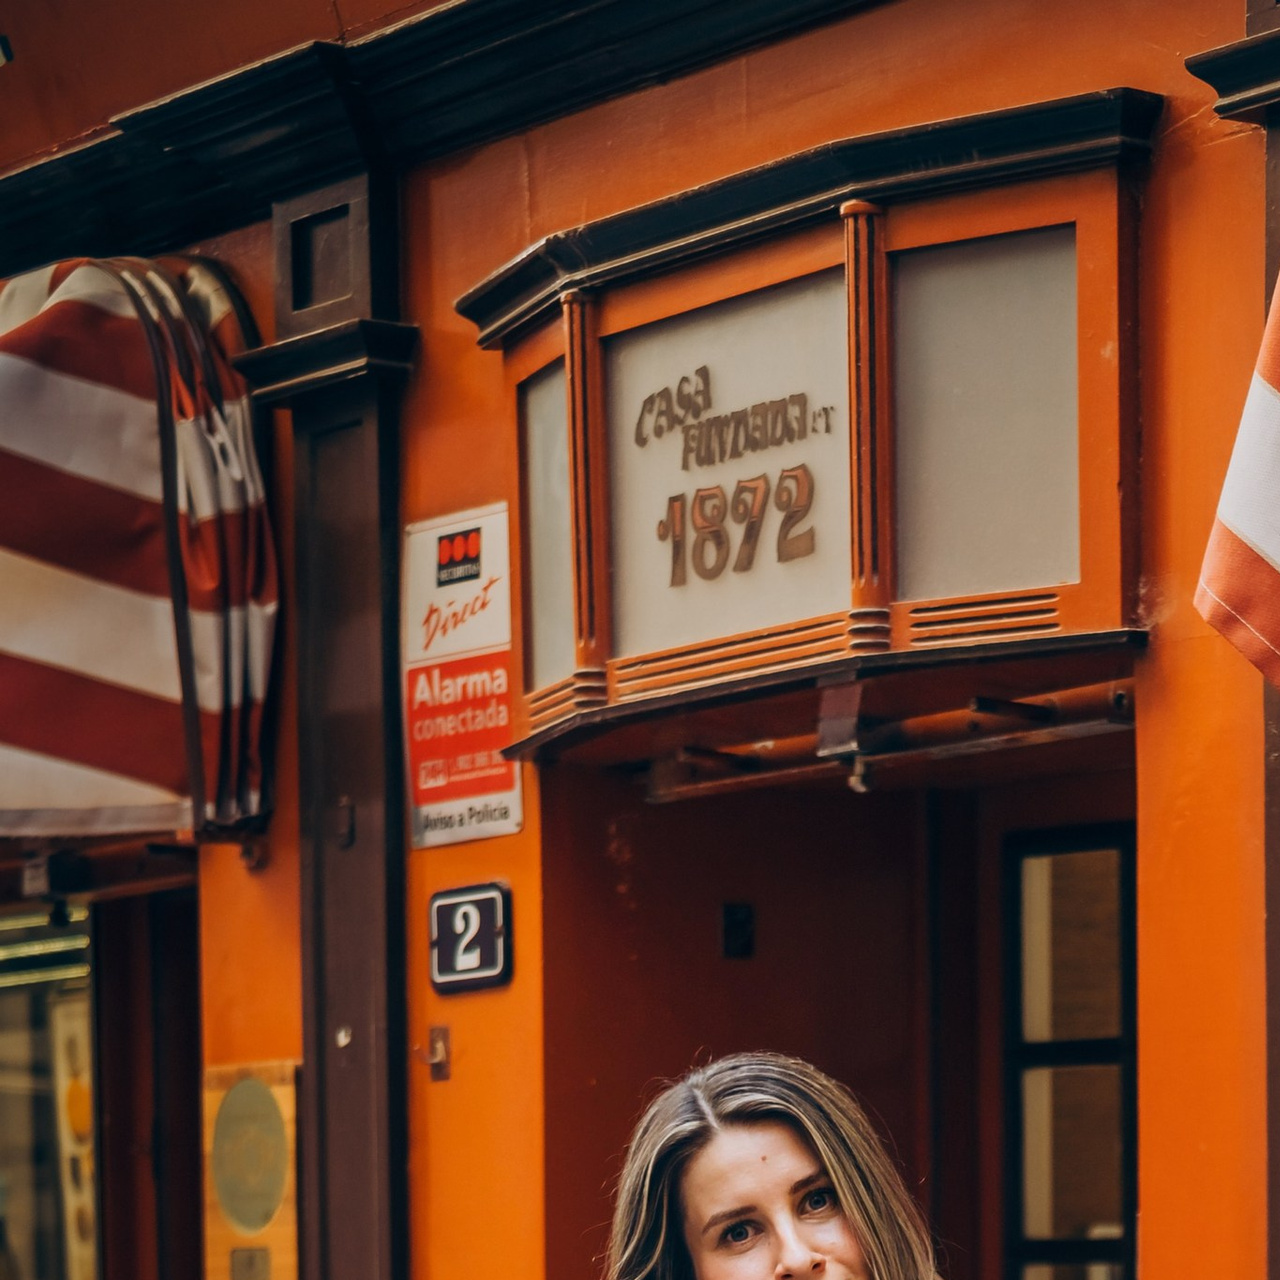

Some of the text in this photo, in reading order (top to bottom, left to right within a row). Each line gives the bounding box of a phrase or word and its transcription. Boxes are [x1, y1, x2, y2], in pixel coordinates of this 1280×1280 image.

[656, 463, 816, 588] 1872
[422, 576, 502, 651] Direct
[413, 667, 509, 710] Alarma
[413, 698, 510, 742] conectada
[454, 903, 481, 972] 2
